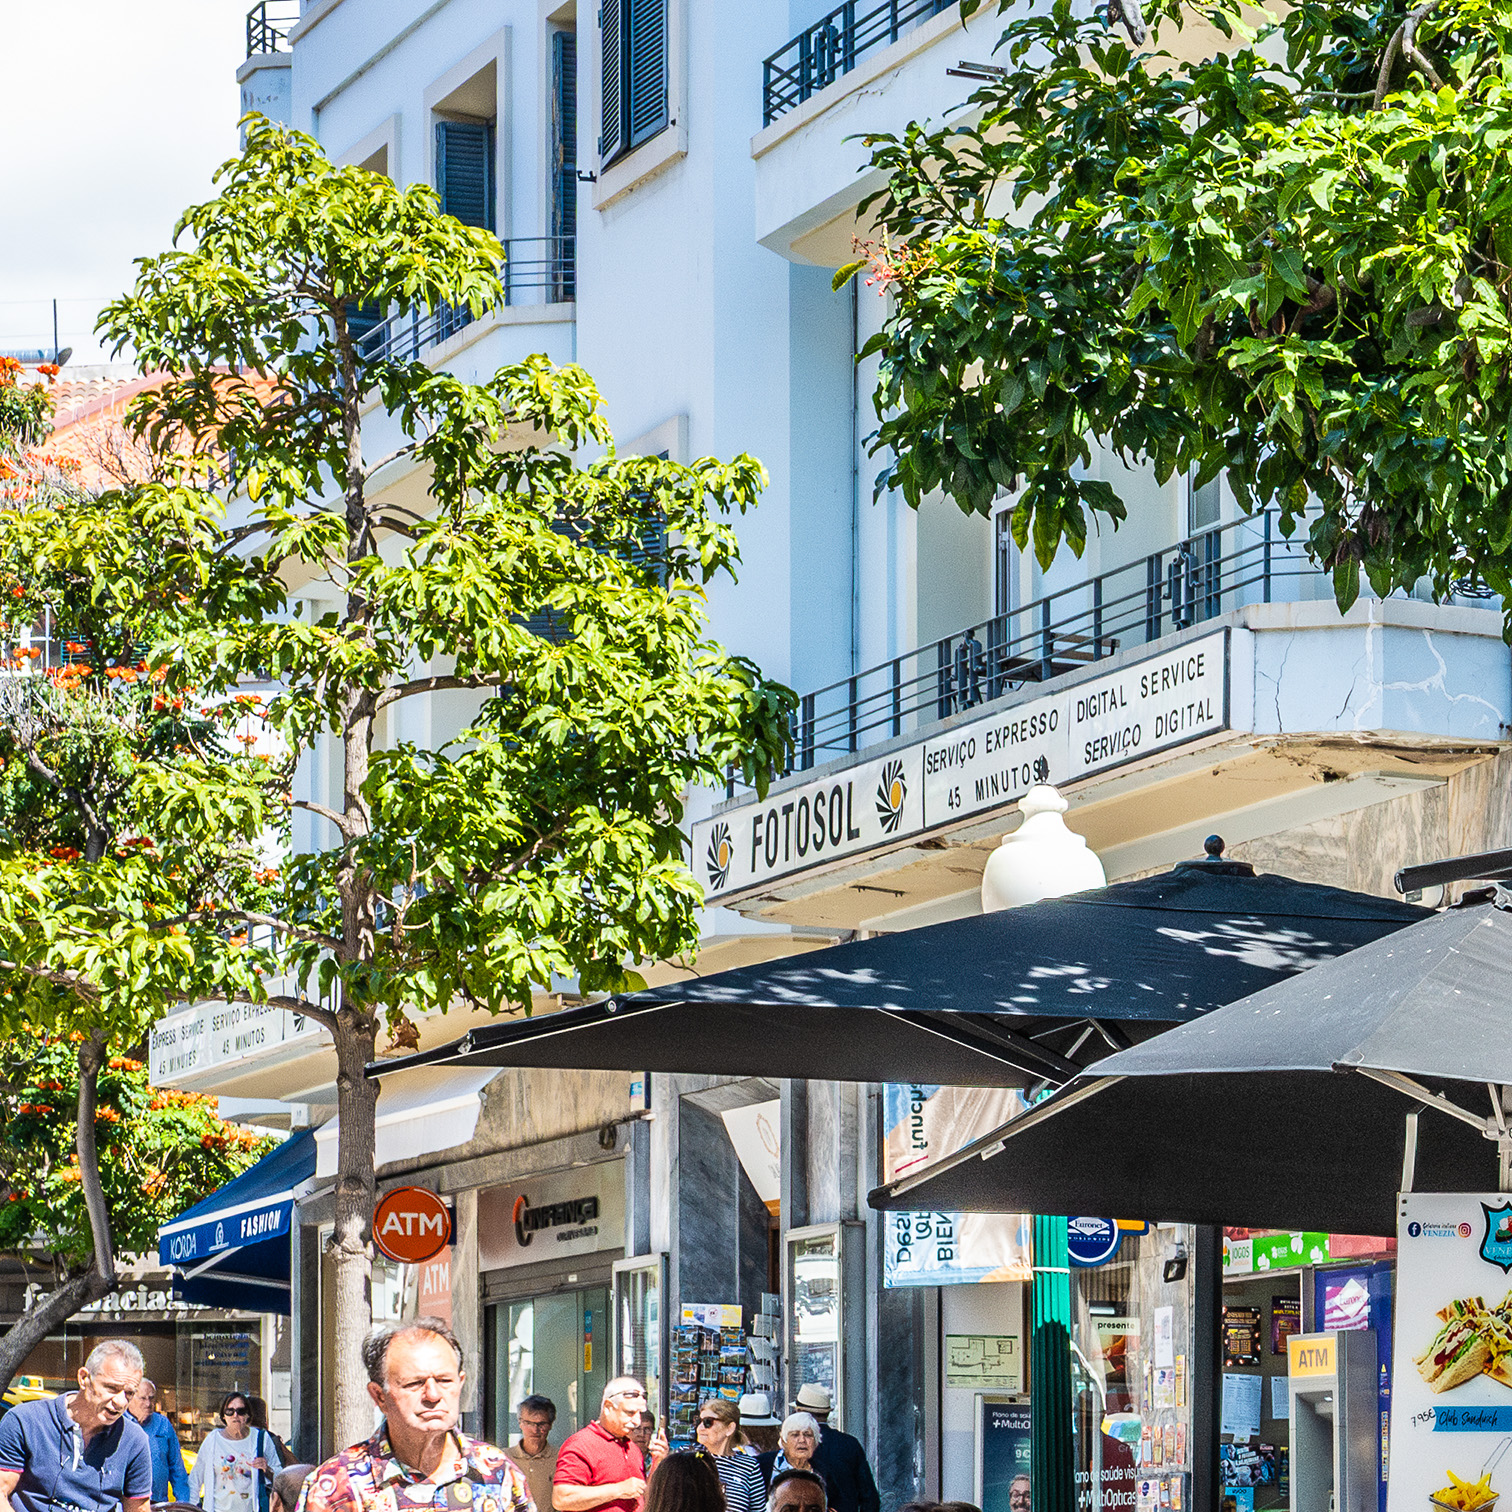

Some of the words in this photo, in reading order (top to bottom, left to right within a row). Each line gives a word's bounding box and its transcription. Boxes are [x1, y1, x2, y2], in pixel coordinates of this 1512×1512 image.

[1076, 684, 1127, 723] DIGITAL
[1140, 653, 1205, 699] SERVICE
[926, 737, 976, 775] SERVIÇO
[985, 708, 1059, 754] EXPRESSO
[1084, 723, 1142, 765] SERVIÇO
[1155, 698, 1214, 741] DIGITAL
[948, 786, 961, 810] 45
[975, 758, 1041, 802] MINUTOS
[751, 781, 860, 873] FOTOSOL
[212, 1008, 240, 1032] SERVIÇO
[152, 1029, 177, 1050] EXPRESS
[222, 1039, 230, 1055] 45
[235, 1027, 265, 1051] MINUTOS
[159, 1062, 166, 1076] 45
[240, 1209, 281, 1239] FASHION
[381, 1210, 444, 1238] ATM
[1422, 1230, 1456, 1238] VENEZIA
[170, 1232, 197, 1261] KORDA
[1232, 1246, 1250, 1262] JOGOS
[423, 1263, 449, 1296] ATM
[1097, 1322, 1135, 1330] presente
[1299, 1348, 1328, 1368] ATM
[1439, 1409, 1458, 1426] Club
